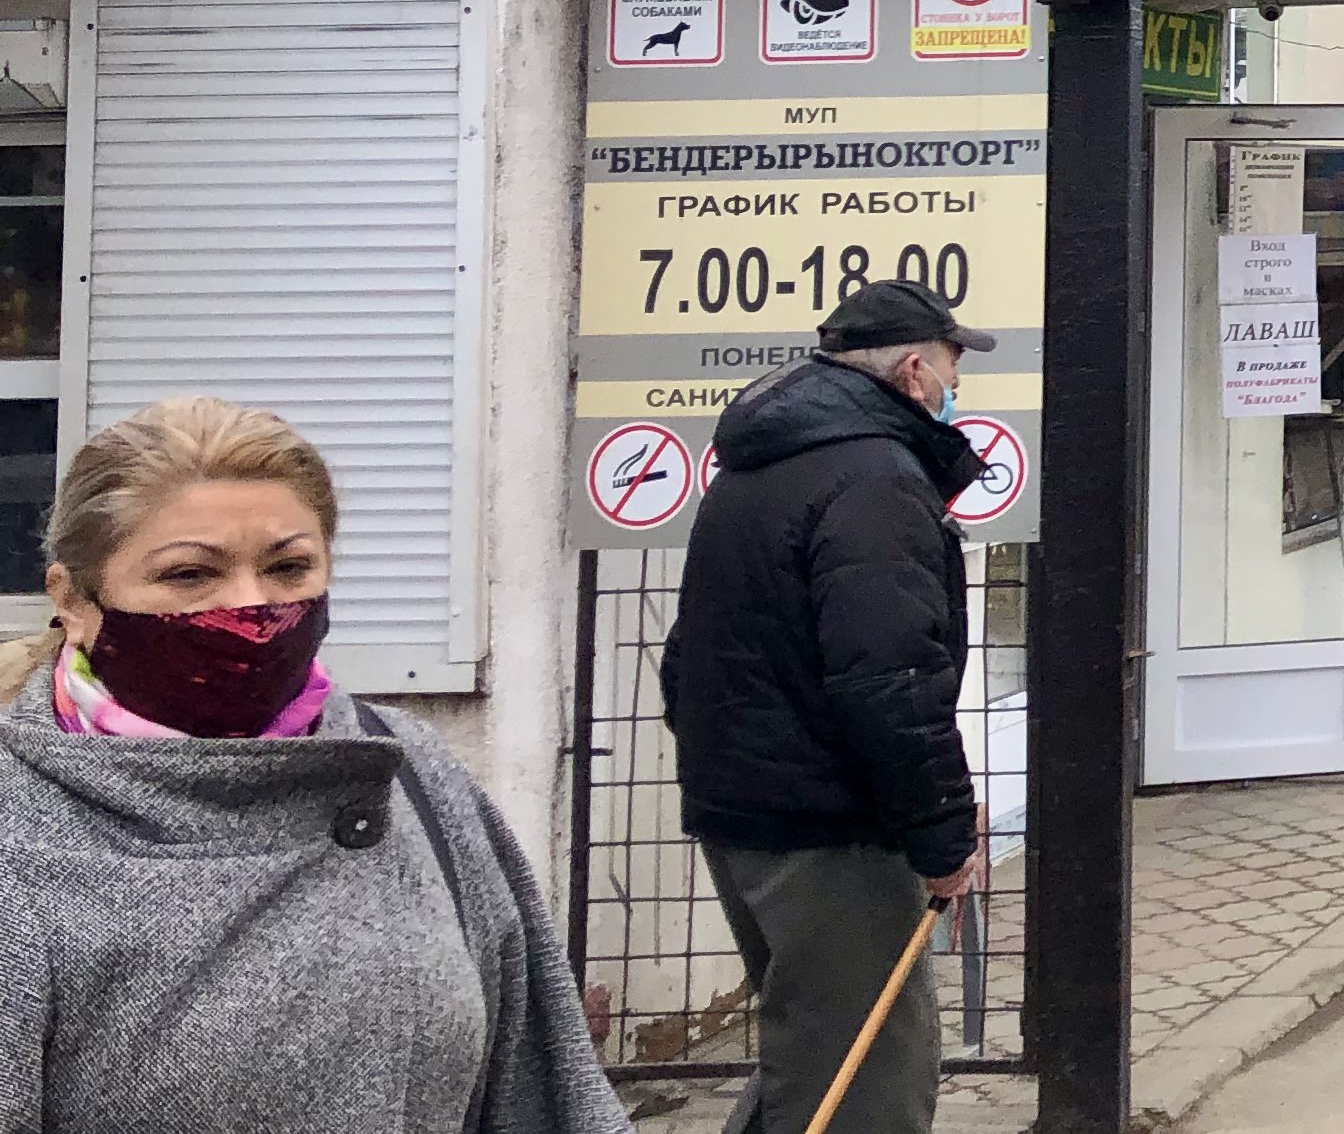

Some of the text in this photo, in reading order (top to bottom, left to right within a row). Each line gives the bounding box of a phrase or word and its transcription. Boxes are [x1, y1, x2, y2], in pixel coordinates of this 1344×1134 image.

[632, 6, 702, 17] СОБАКАМИ
[915, 29, 1026, 48] ЗАПРЕЩЕНА!
[770, 41, 868, 53] ВИДЕОНАБЛЮДЕНИЕ
[784, 107, 838, 125] МУП
[591, 139, 1040, 177] “БЕНДЕРЫРЫНОКТОРГ”
[657, 190, 976, 219] ГРАФИК РАБОТЫ
[1249, 239, 1286, 252] Вход
[1244, 258, 1292, 271] строго
[1243, 287, 1293, 296] масках
[1224, 320, 1316, 342] ЛАВАШ
